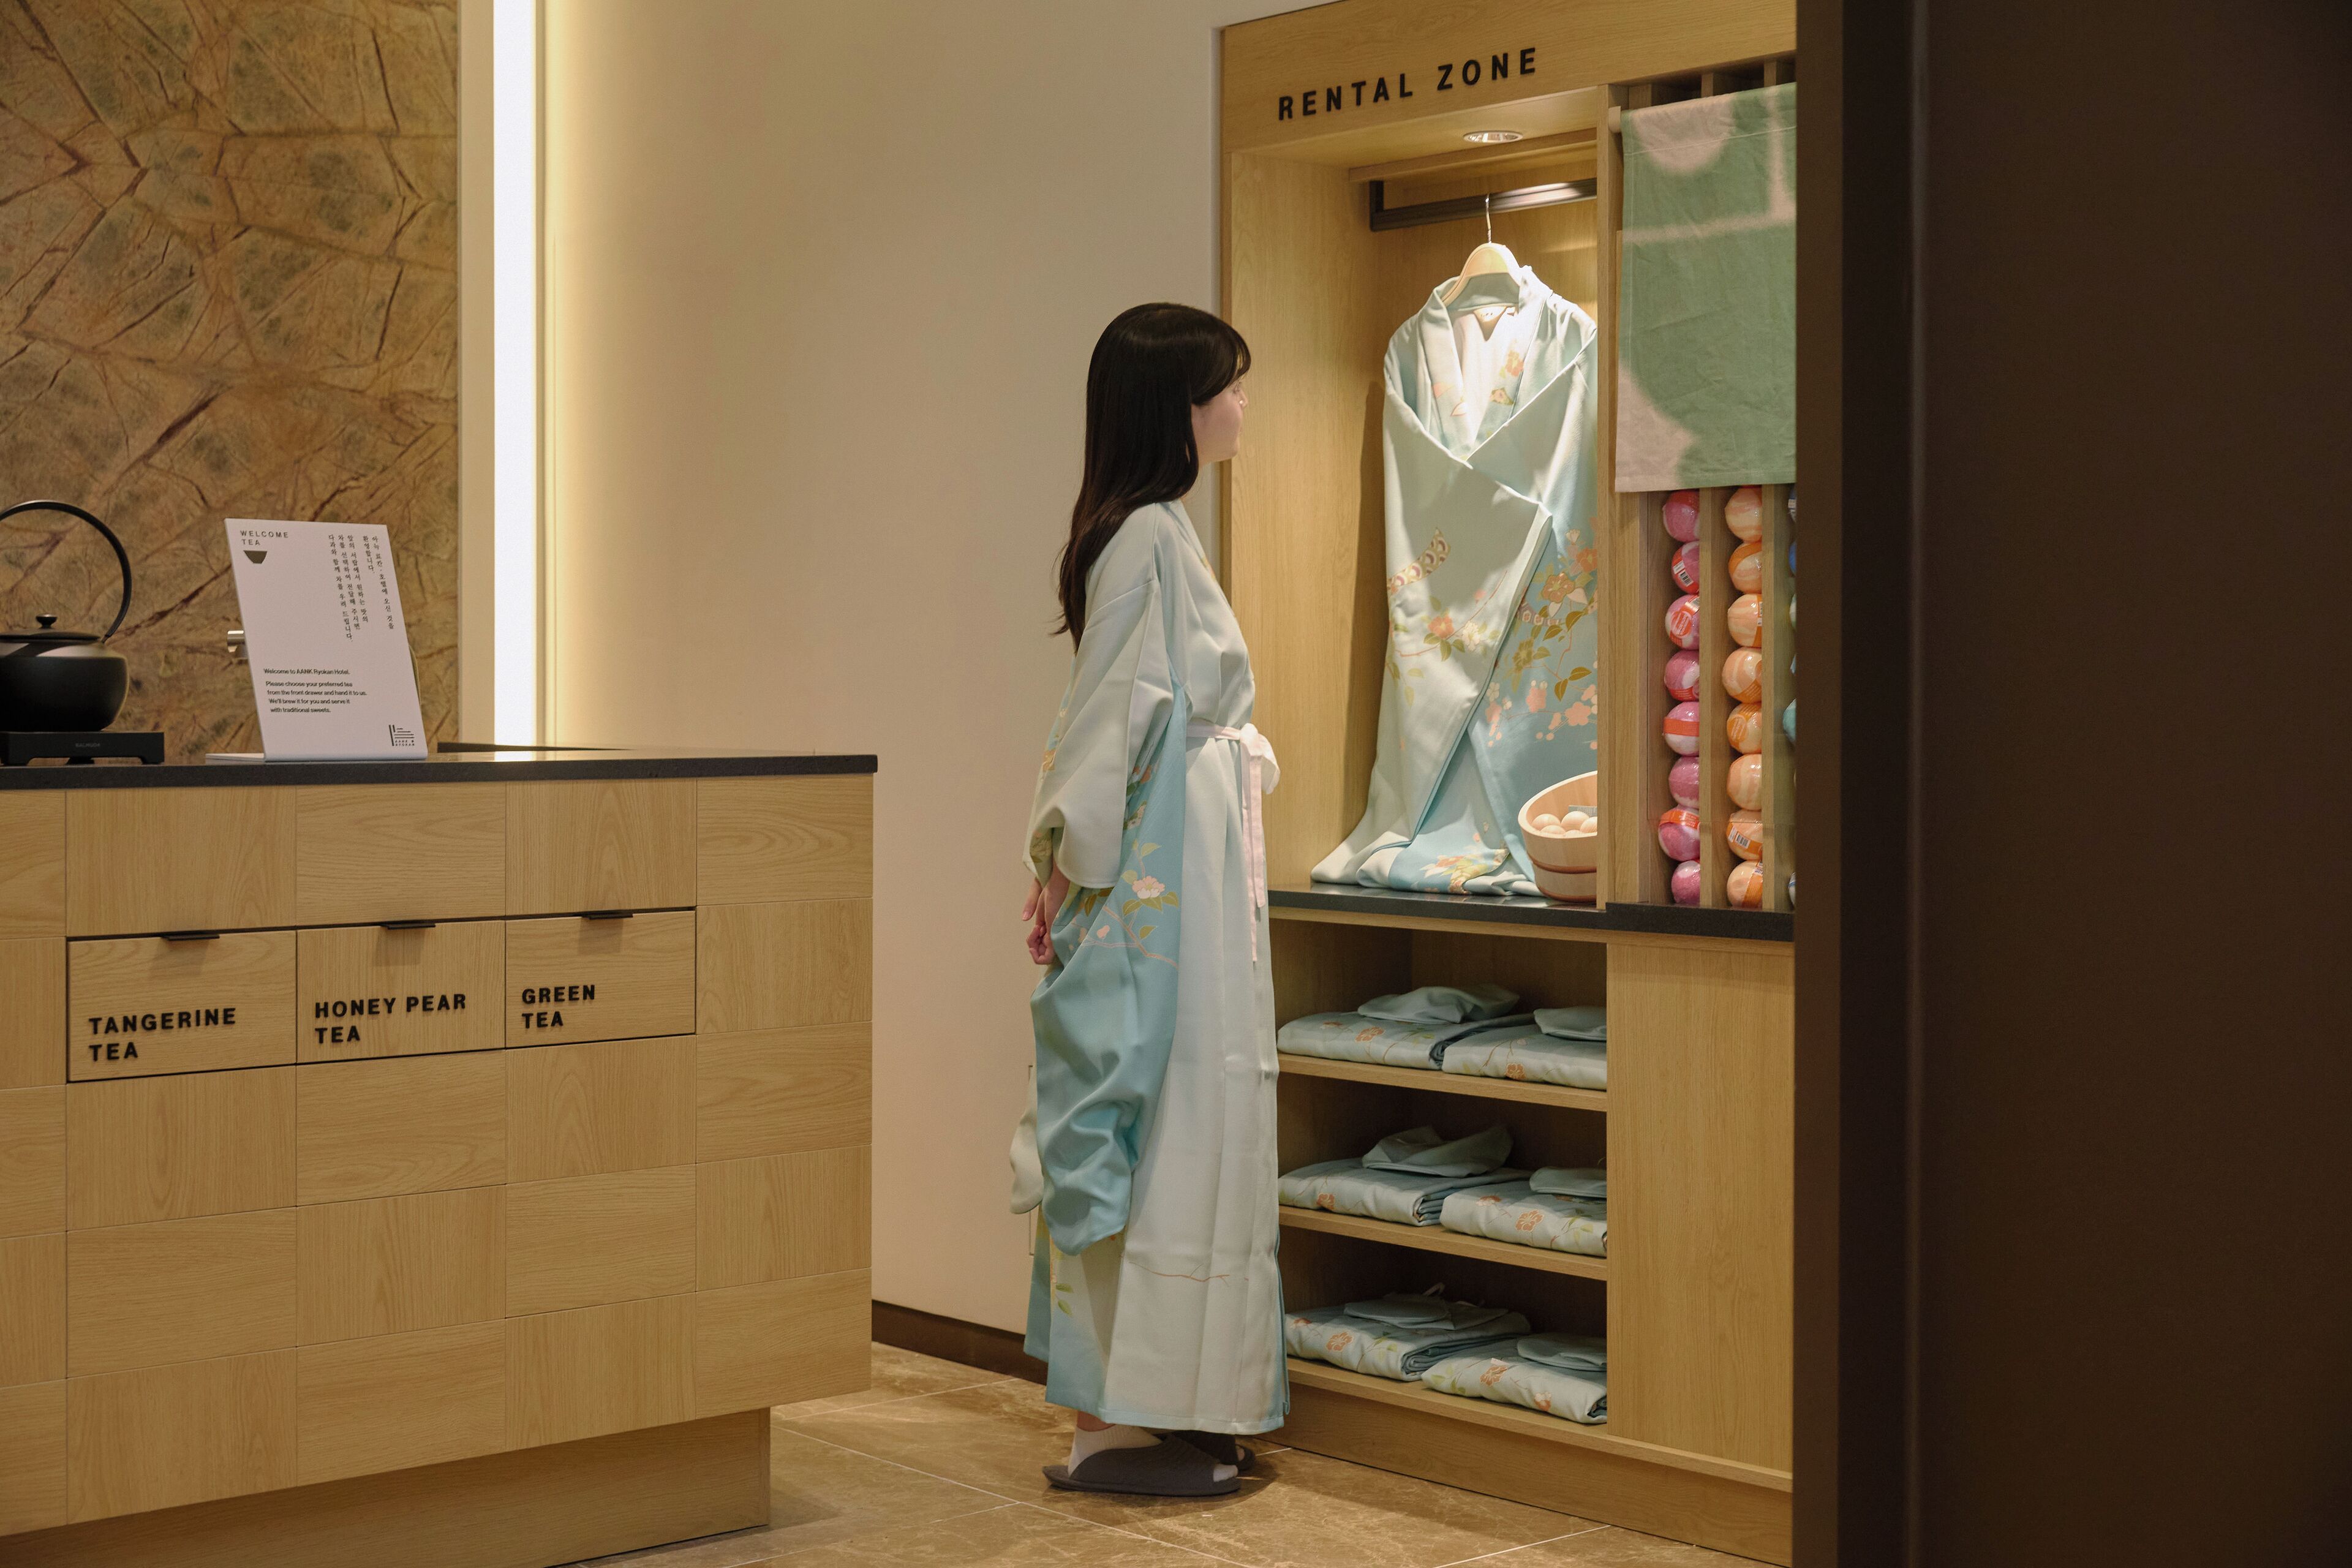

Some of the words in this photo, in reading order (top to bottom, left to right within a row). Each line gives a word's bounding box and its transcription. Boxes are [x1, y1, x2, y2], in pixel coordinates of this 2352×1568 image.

[1278, 73, 1413, 121] RENTAL
[1437, 47, 1536, 91] ZONE
[363, 535, 375, 574] 환영합니다.
[351, 552, 361, 581] 서랍에서
[356, 584, 366, 605] 원하는
[383, 598, 391, 612] 오신
[342, 611, 353, 642] 드립니다.
[352, 608, 360, 630] 주시면
[315, 998, 396, 1019] HONEY
[406, 993, 466, 1012] PEAR
[522, 984, 595, 1005] GREEN
[89, 1008, 236, 1035] TANGERINE
[522, 1011, 564, 1029] TEA
[315, 1025, 361, 1044] TEA
[89, 1042, 138, 1061] TEA
